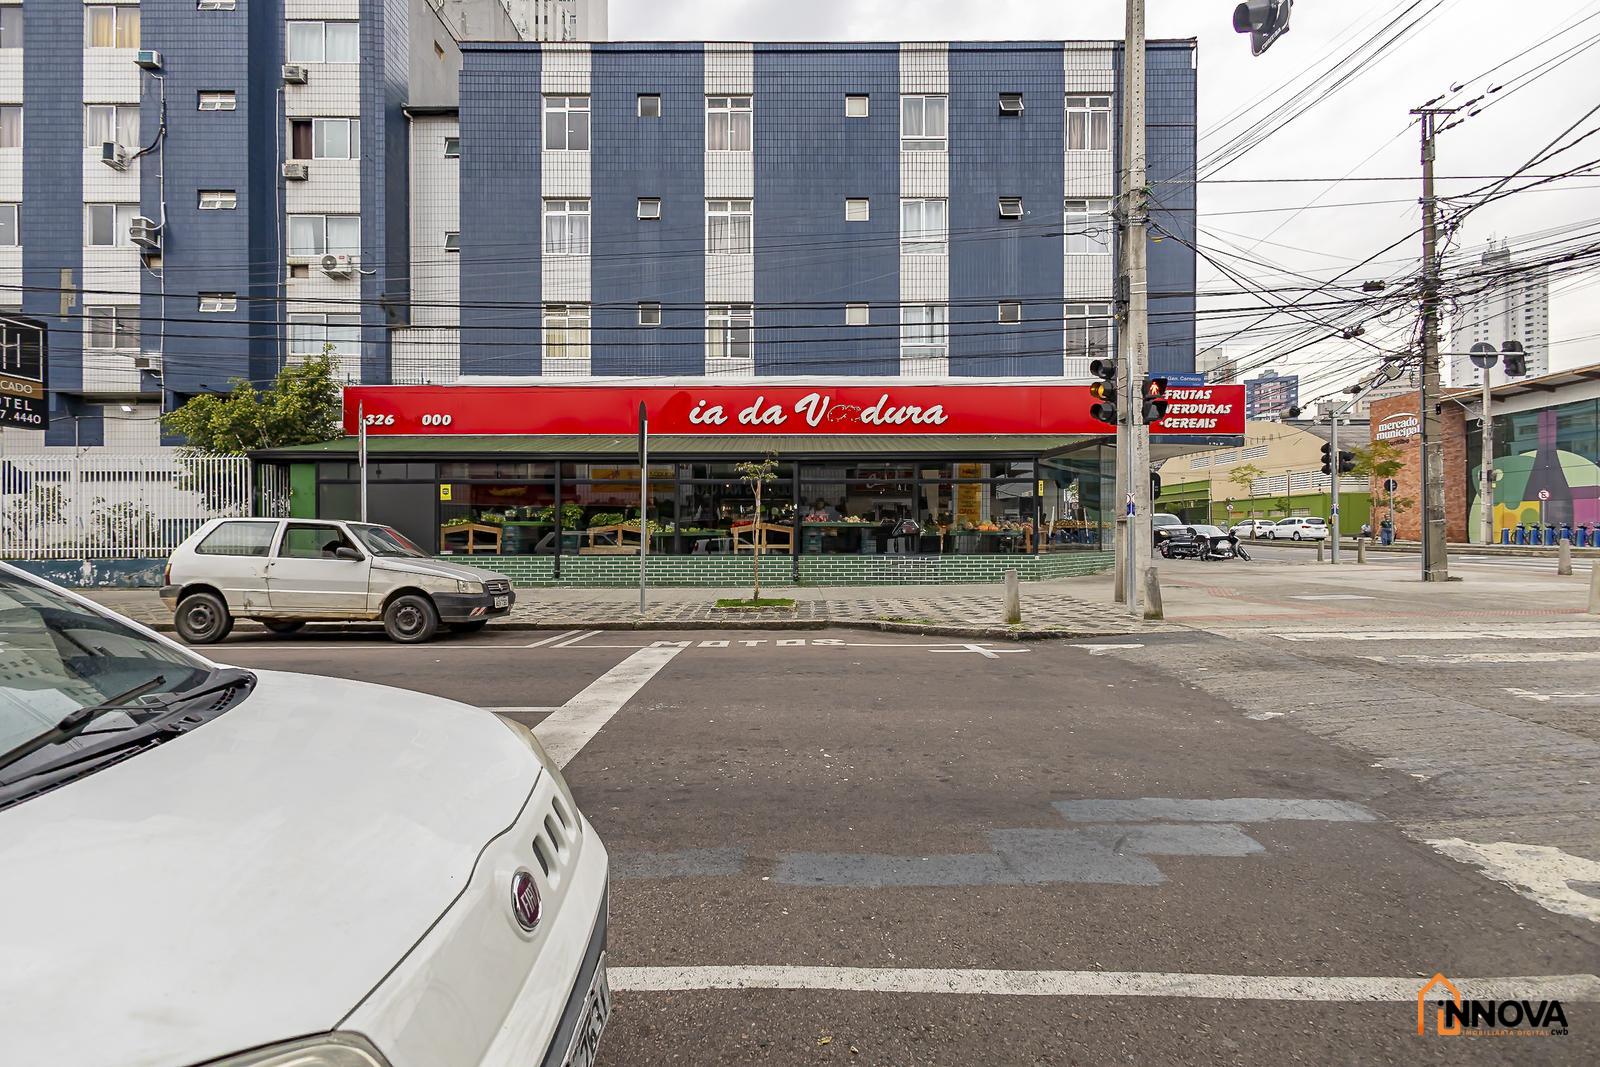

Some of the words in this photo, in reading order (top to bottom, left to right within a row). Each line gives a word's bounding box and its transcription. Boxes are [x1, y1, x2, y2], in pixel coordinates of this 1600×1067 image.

[1164, 389, 1212, 400] FRUTAS
[737, 396, 789, 426] da
[421, 414, 452, 426] 000
[1378, 416, 1419, 432] mercado
[1376, 424, 1422, 441] municipal
[647, 637, 848, 648] MOTOS
